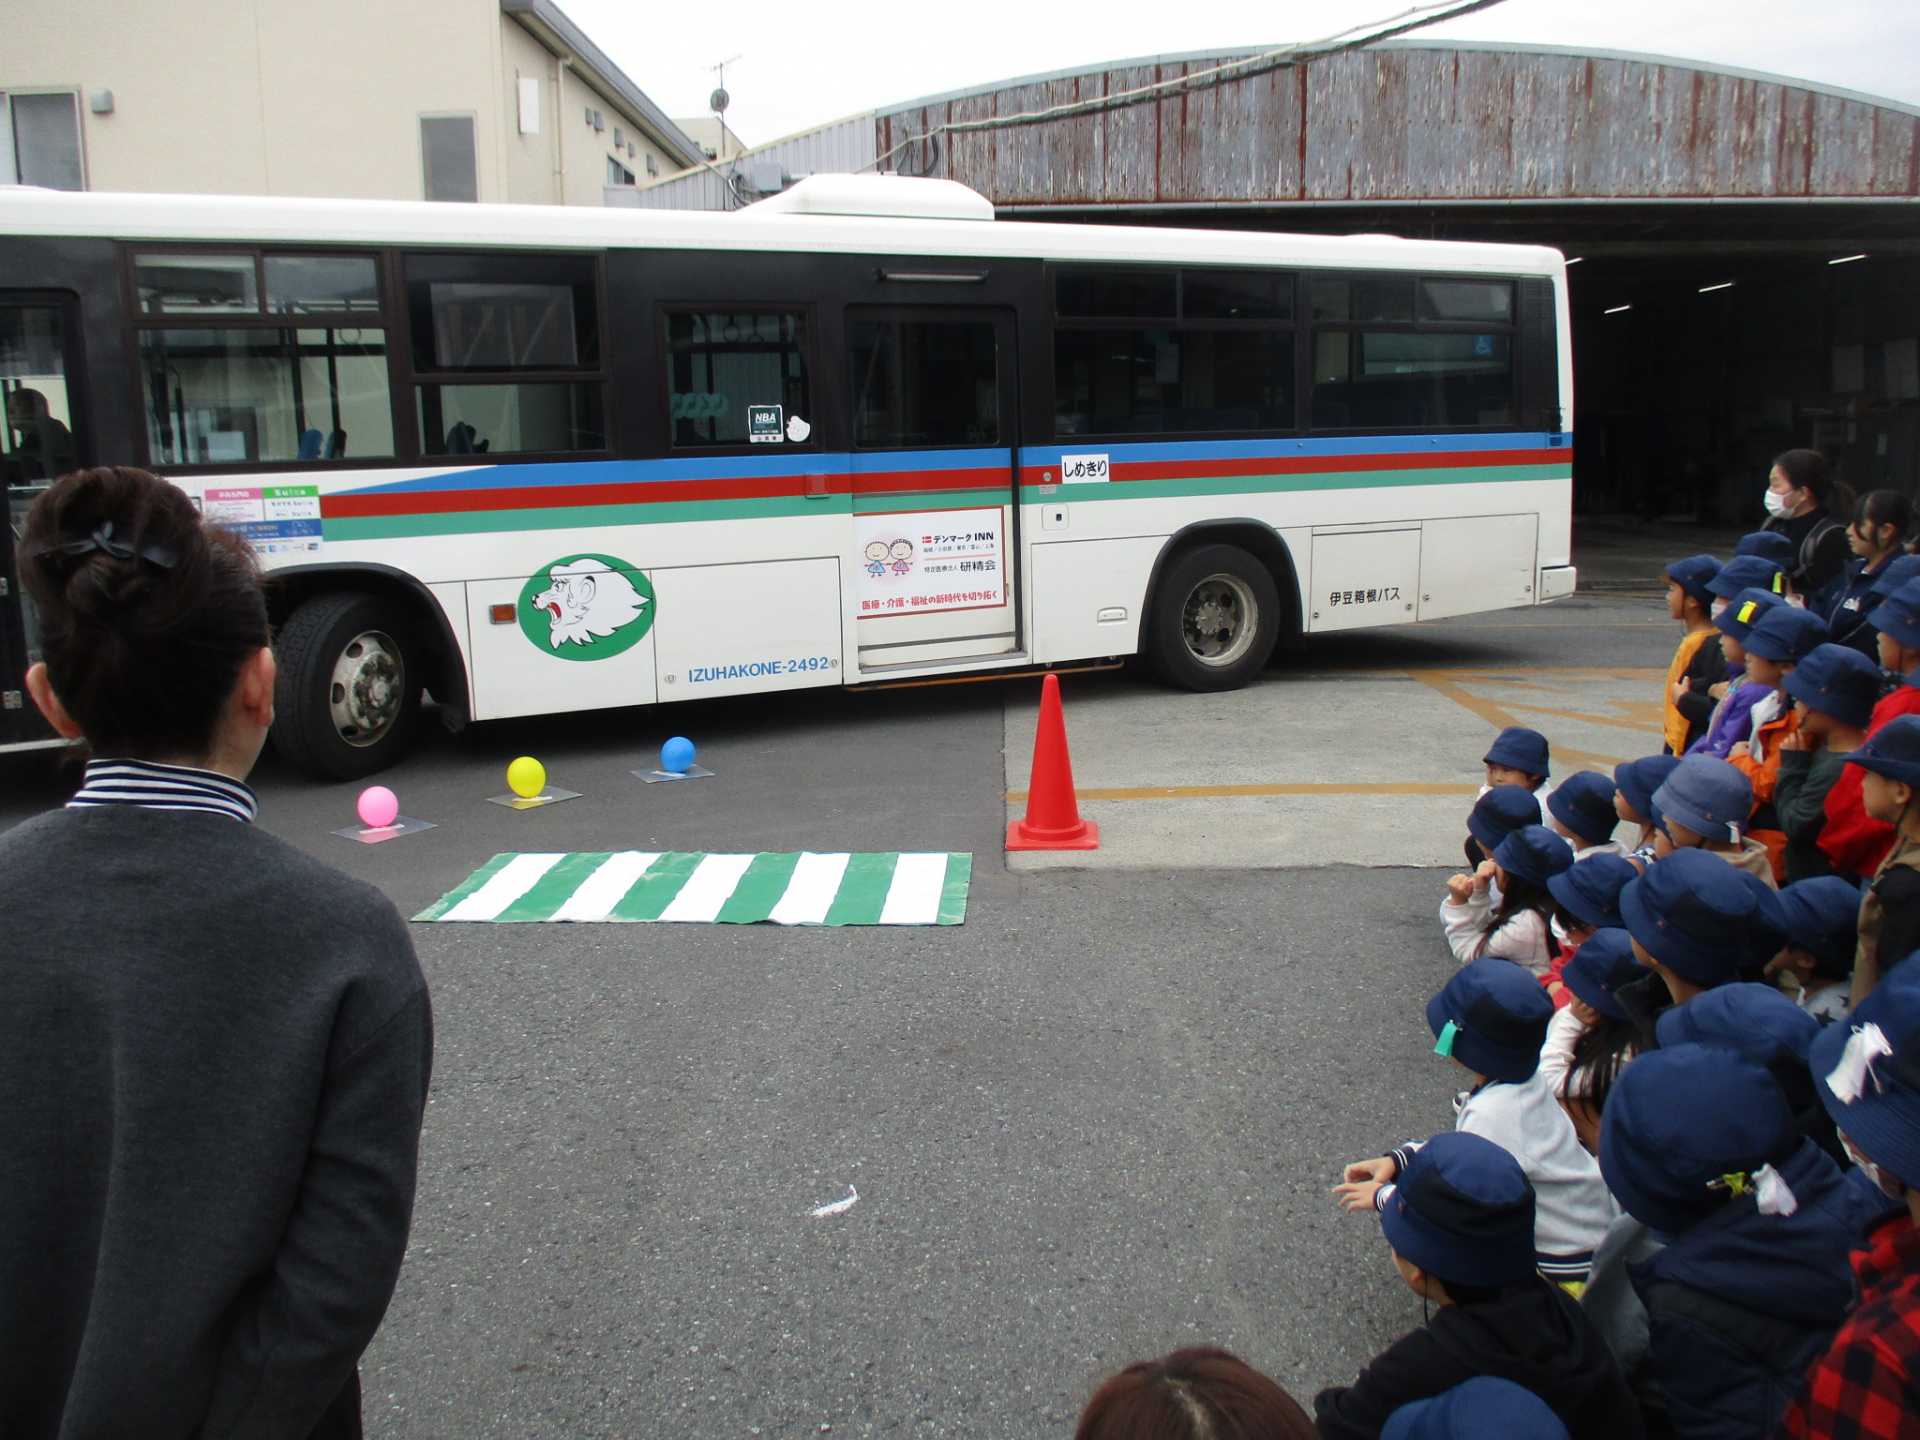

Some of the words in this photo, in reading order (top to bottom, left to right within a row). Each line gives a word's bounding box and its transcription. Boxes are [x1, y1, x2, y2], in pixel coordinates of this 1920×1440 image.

[755, 413, 777, 424] NBA
[1064, 460, 1107, 477] しめきり
[974, 532, 994, 541] INN
[1330, 587, 1400, 607] 伊豆箱根バス
[688, 656, 829, 683] IZUHAKONE-2492
